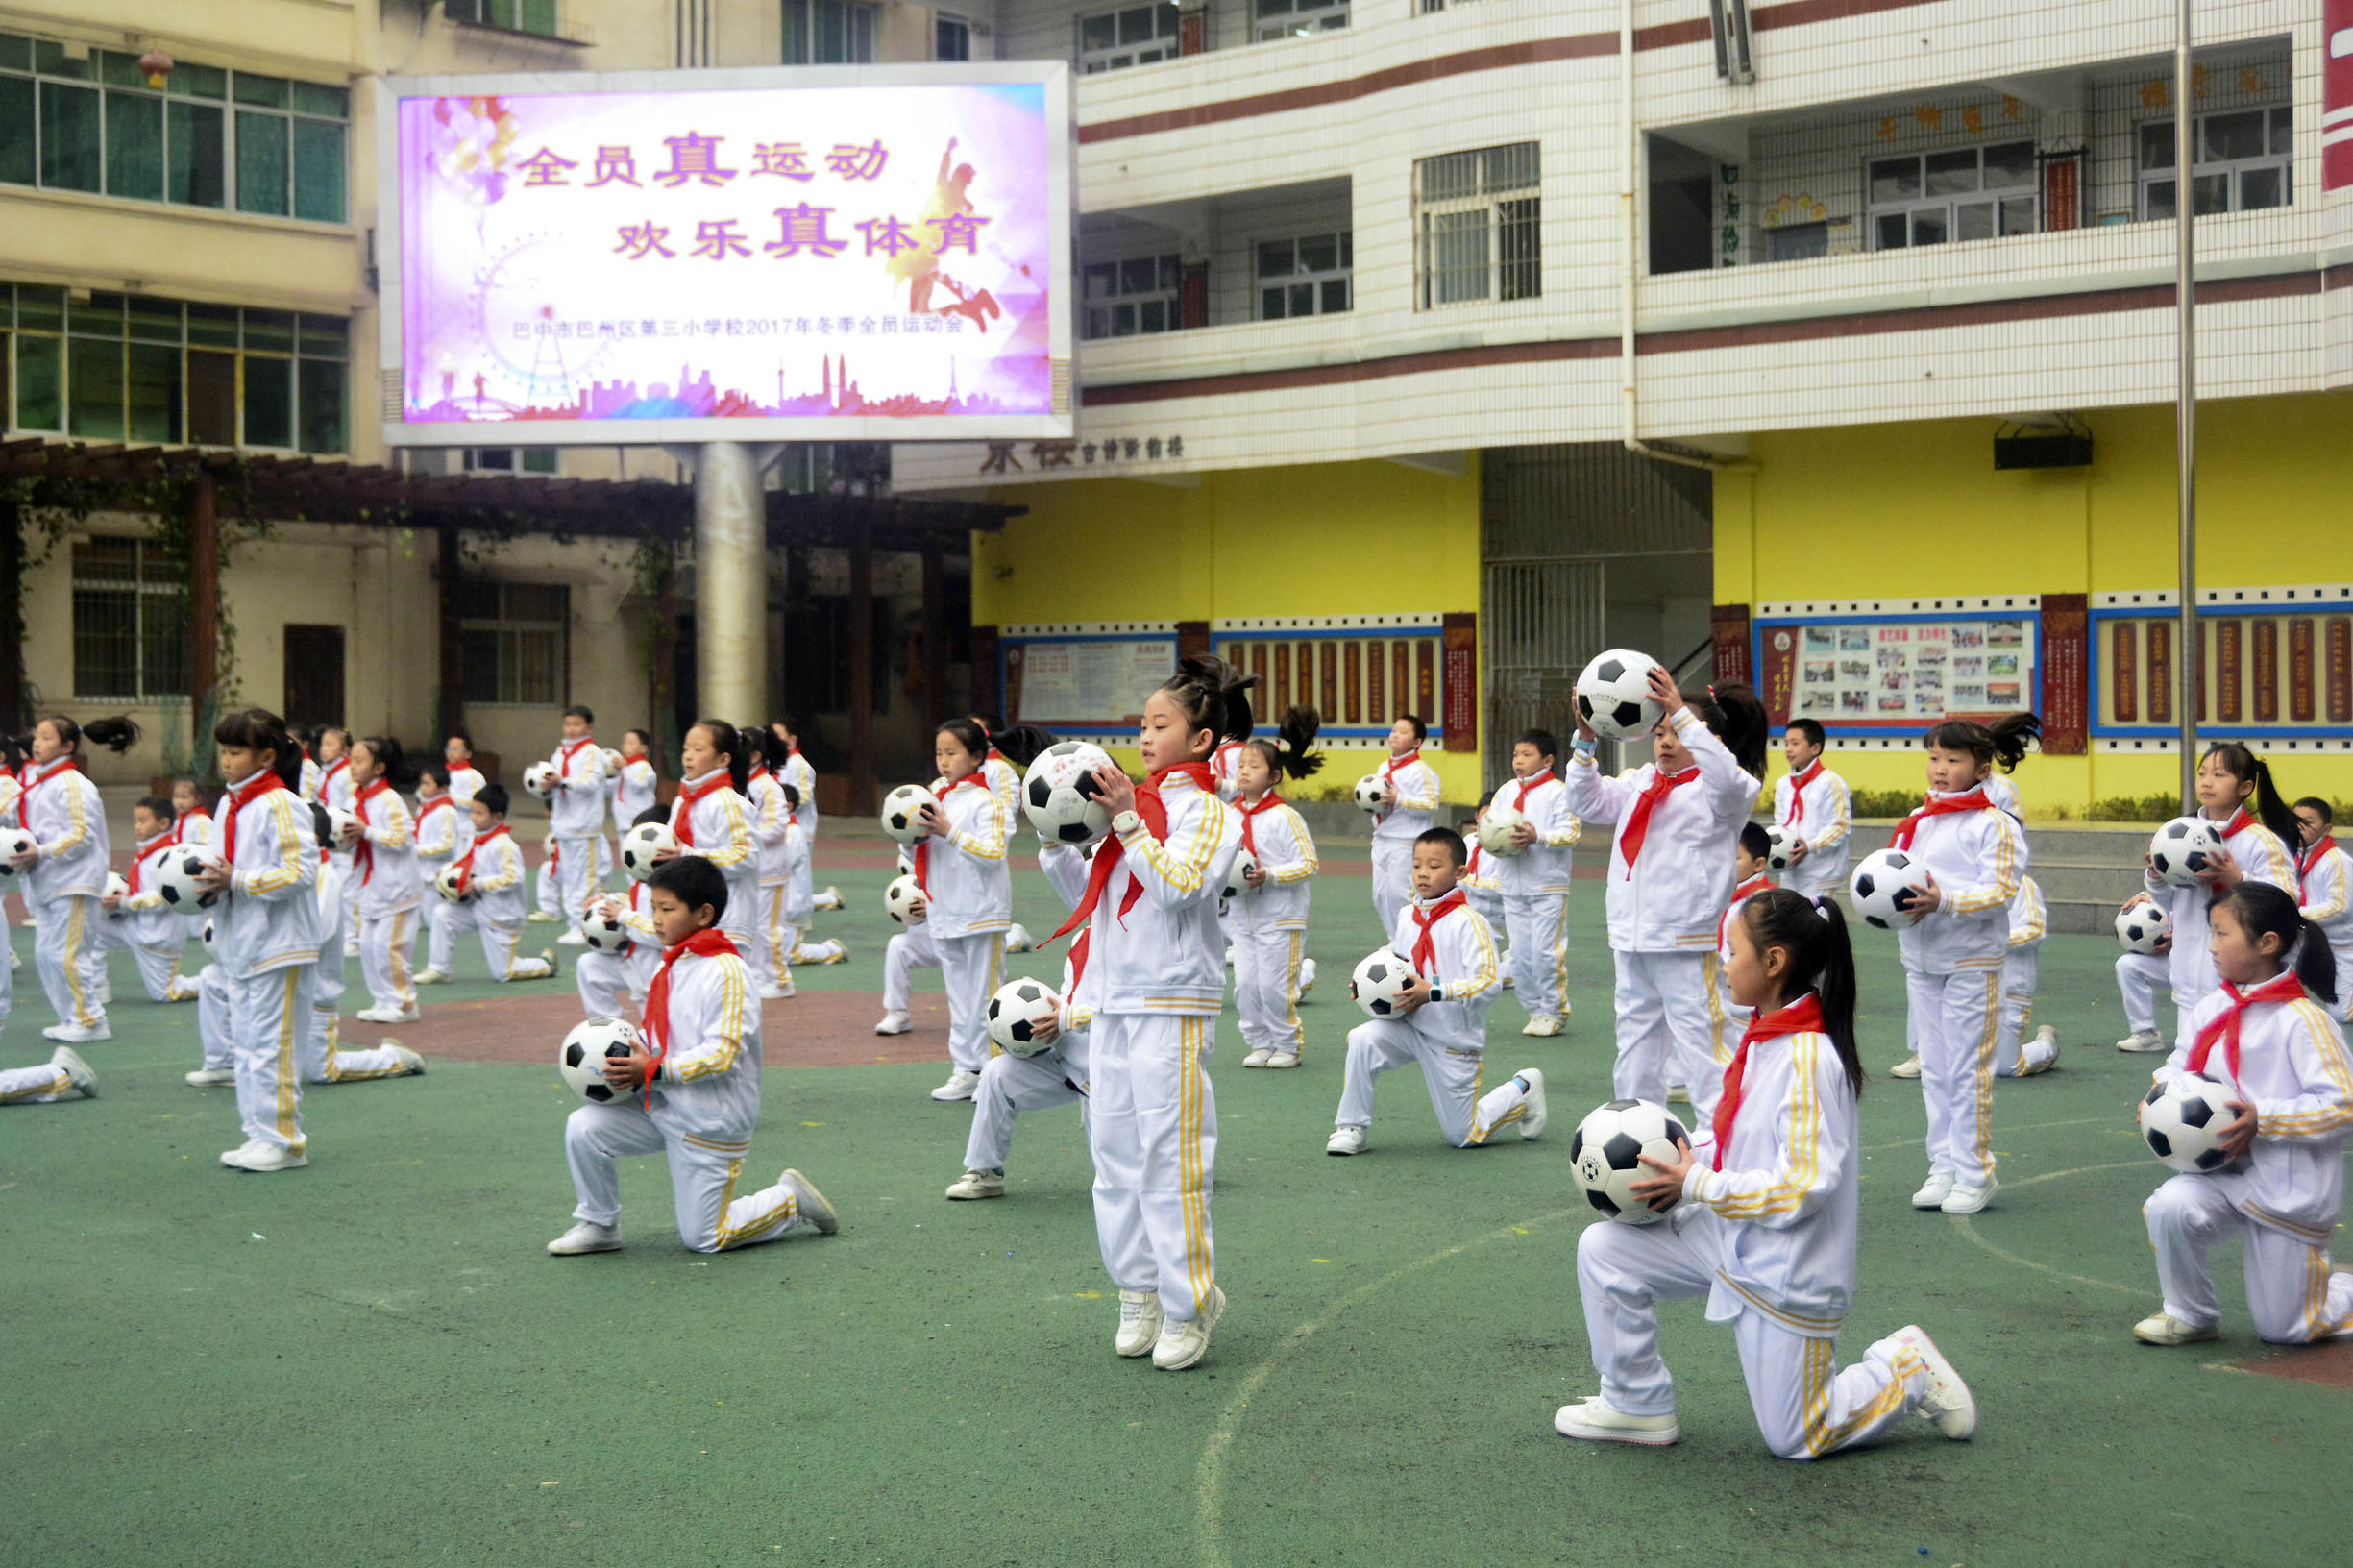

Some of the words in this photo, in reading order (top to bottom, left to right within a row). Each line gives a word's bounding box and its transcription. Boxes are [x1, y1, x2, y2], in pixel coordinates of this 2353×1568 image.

[516, 131, 889, 188] 全员真运动
[613, 202, 992, 259] 欢乐真体育
[512, 312, 964, 340] 巴中市巴州区第三小学校2017年冬季全员运动会
